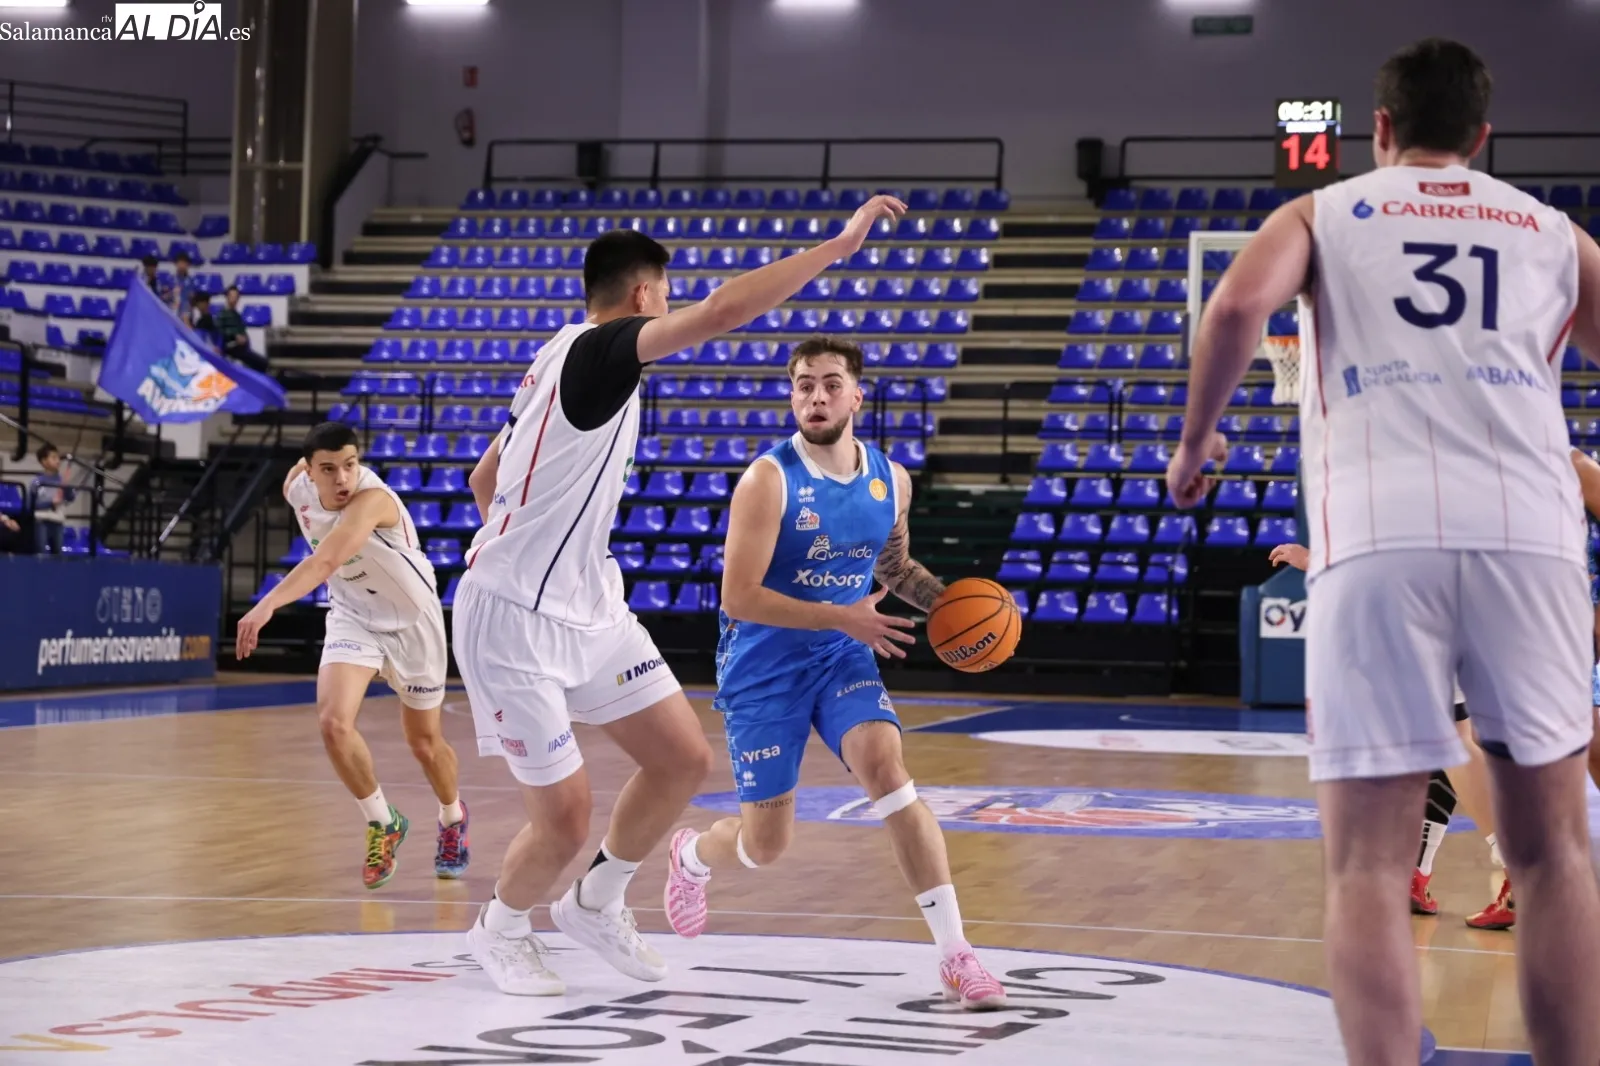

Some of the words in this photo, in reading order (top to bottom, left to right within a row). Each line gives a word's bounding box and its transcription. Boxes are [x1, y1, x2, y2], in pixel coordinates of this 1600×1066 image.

[1282, 134, 1330, 170] 14
[1394, 241, 1499, 331] 31
[941, 632, 997, 663] Wilson
